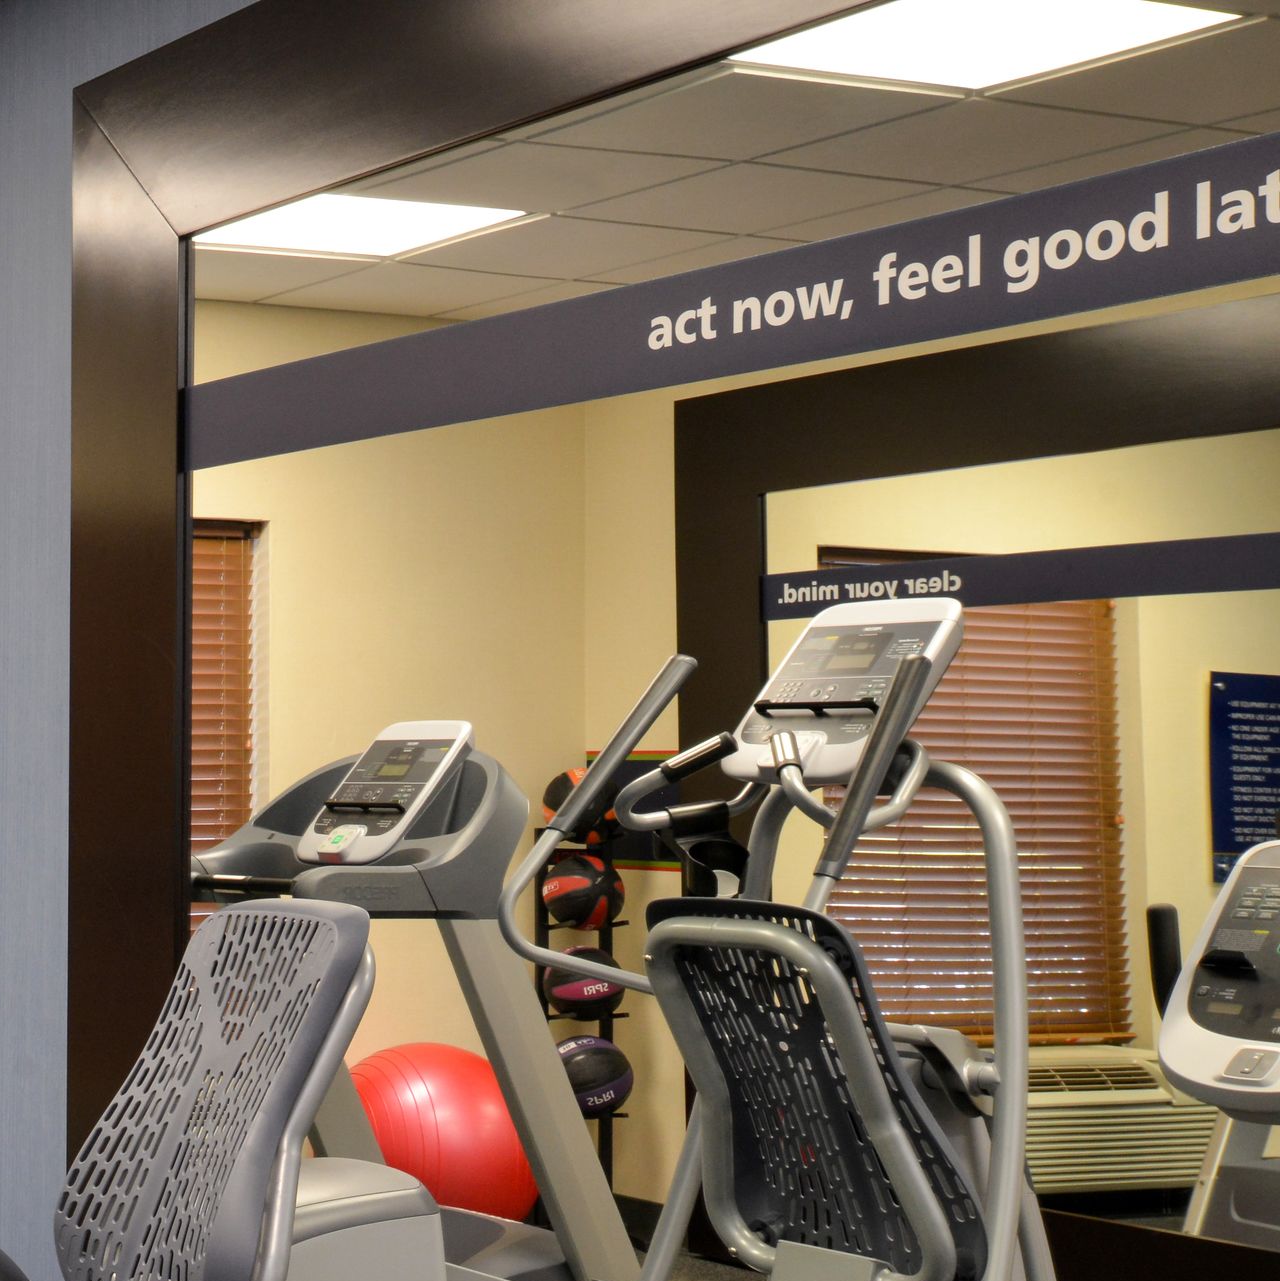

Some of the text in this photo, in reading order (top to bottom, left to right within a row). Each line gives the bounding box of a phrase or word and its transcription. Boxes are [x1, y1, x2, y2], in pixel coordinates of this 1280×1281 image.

[647, 298, 717, 350] act
[732, 277, 853, 334] now,
[872, 234, 982, 306] feel
[1002, 190, 1170, 294] good
